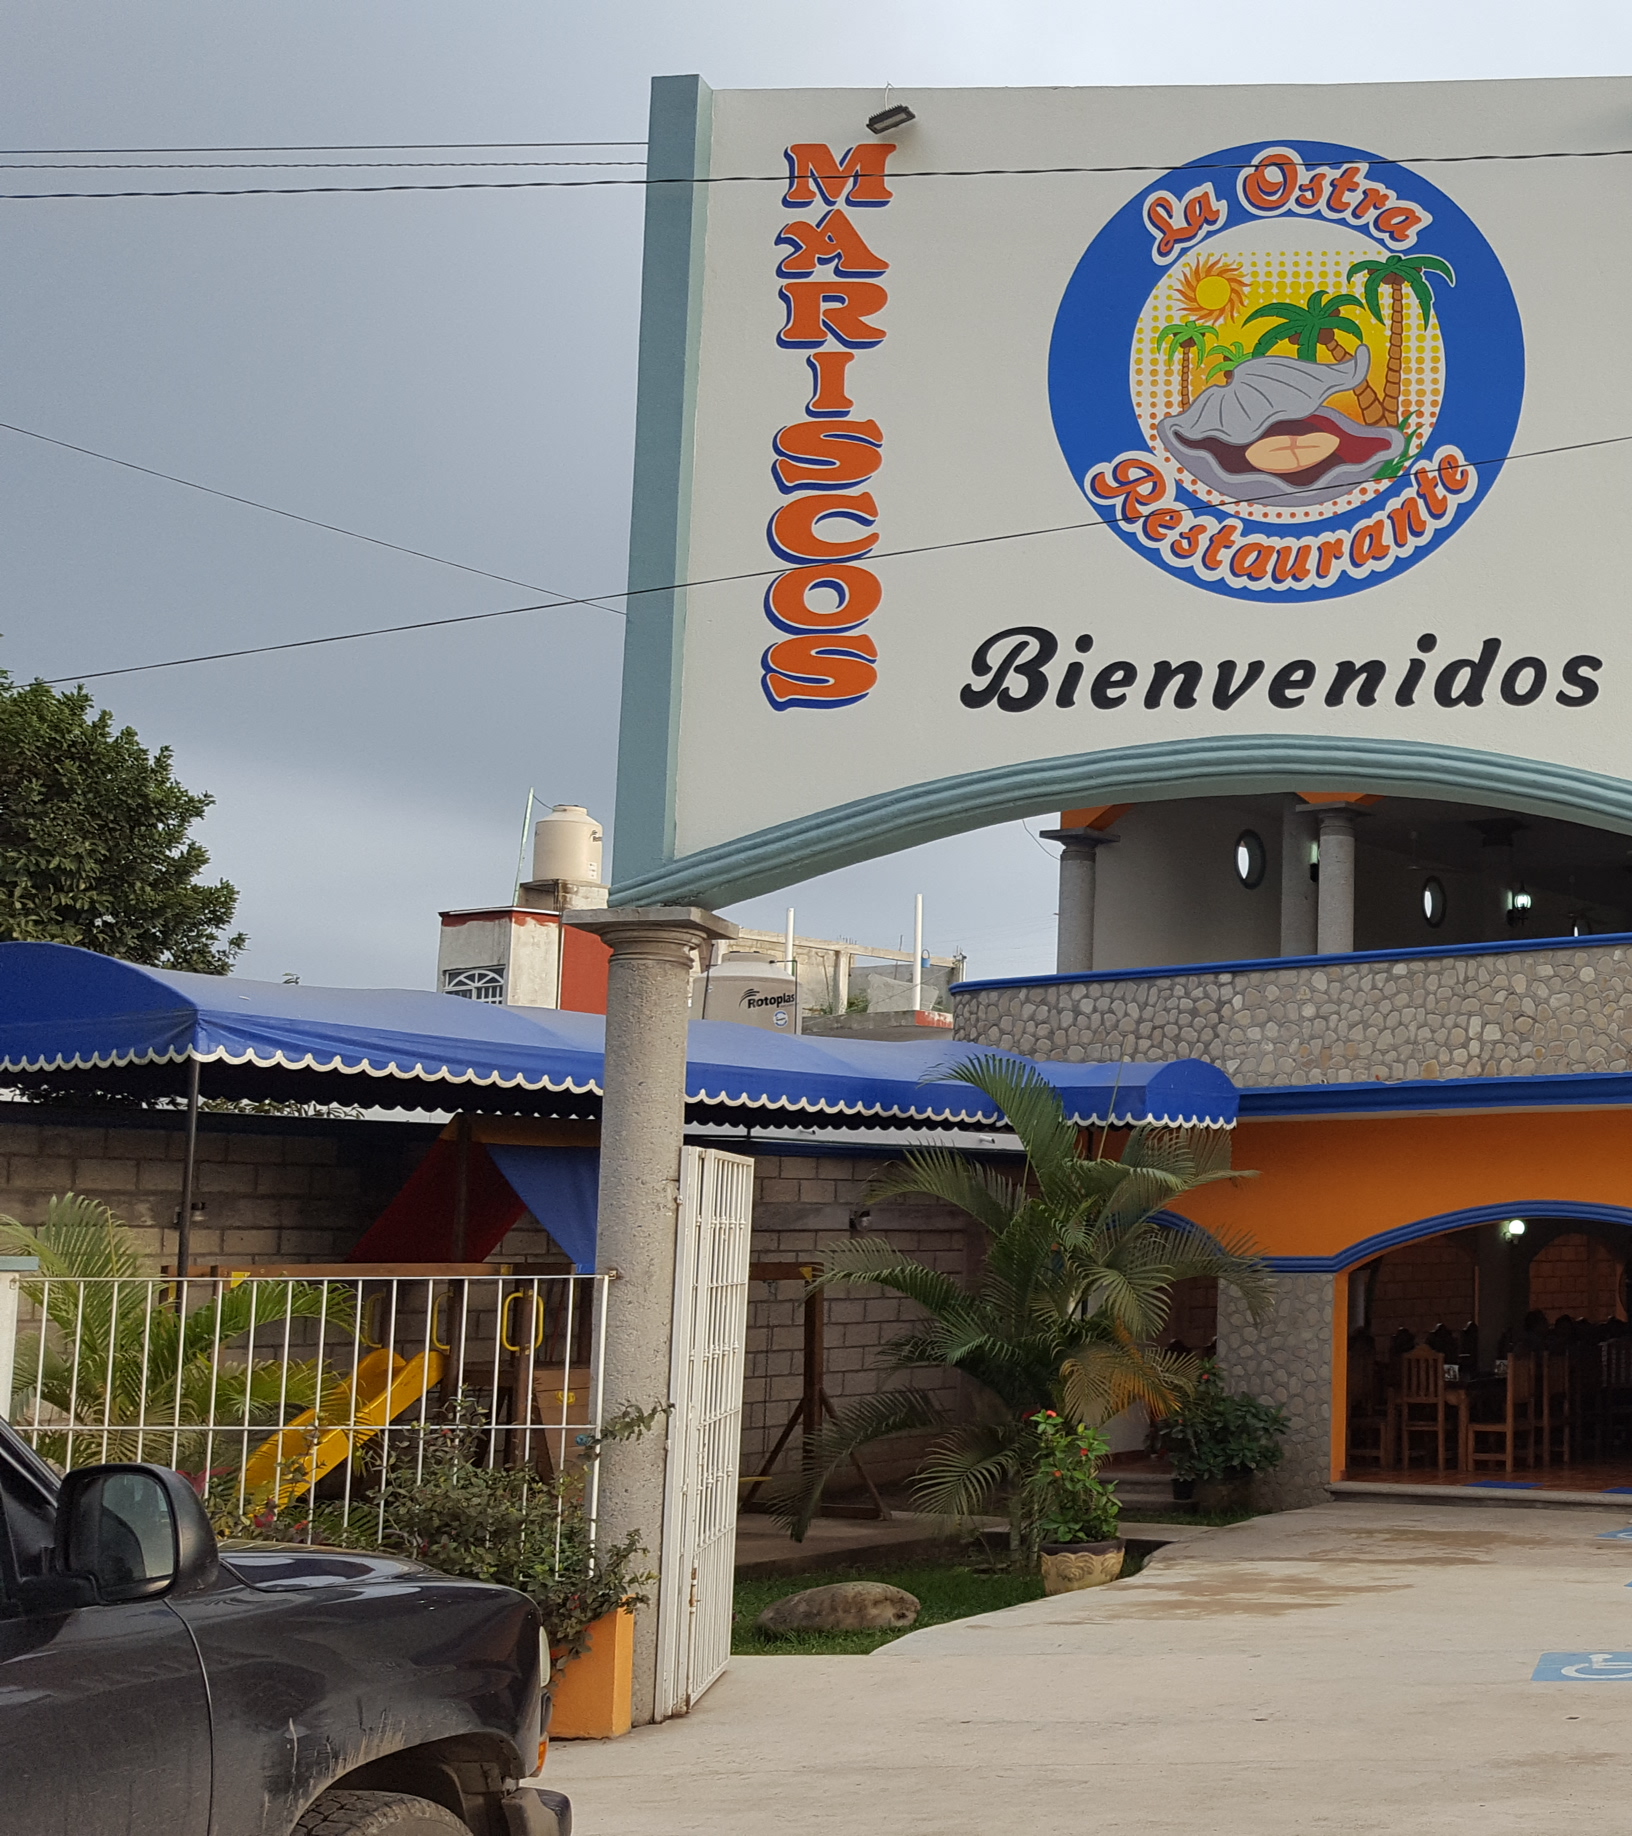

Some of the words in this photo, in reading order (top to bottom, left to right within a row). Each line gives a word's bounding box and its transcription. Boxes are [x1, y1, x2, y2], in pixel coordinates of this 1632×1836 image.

[1147, 190, 1221, 258] La
[1243, 152, 1423, 243] Ostra
[760, 142, 898, 713] MARISCOS
[1091, 453, 1470, 584] Restaurante
[959, 625, 1604, 712] Bienvenidos
[748, 992, 795, 1009] Rotoplas
